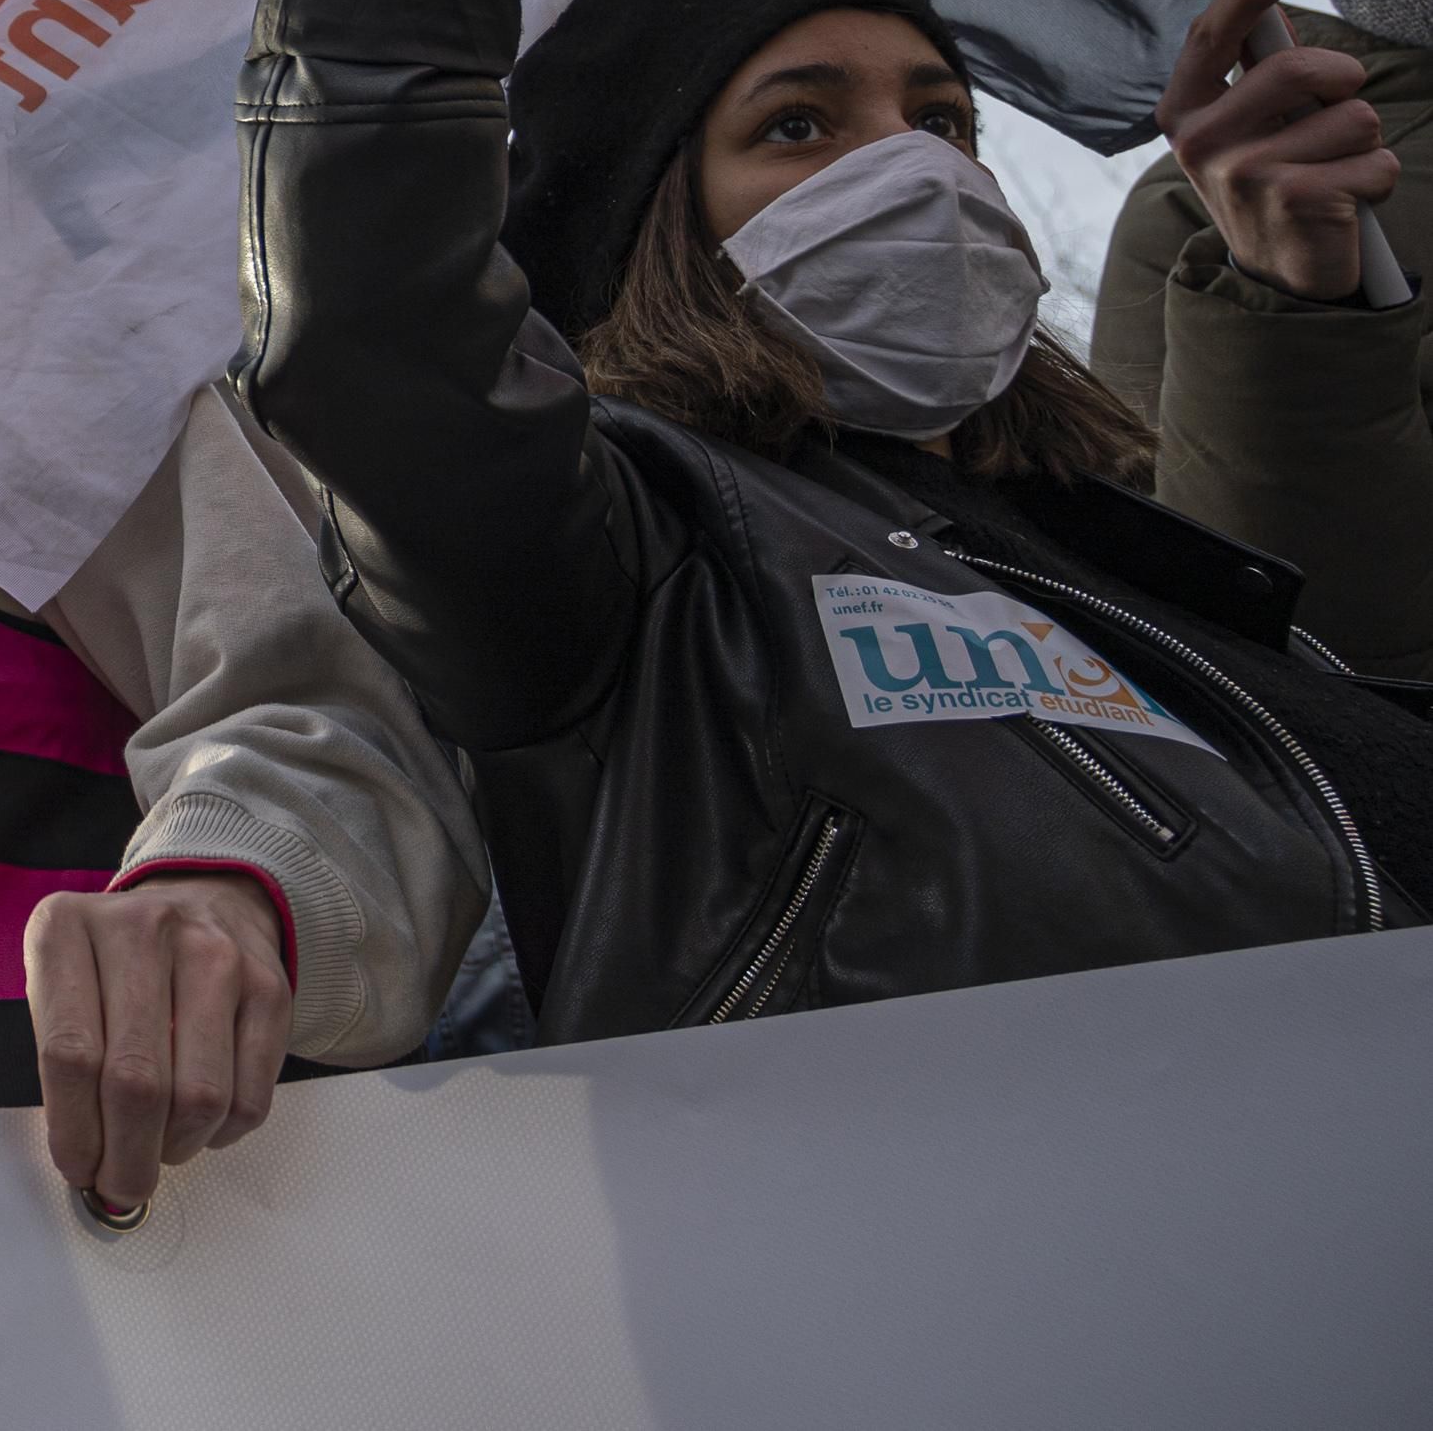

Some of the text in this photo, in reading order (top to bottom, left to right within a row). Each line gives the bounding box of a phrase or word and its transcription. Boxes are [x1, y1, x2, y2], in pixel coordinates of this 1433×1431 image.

[833, 600, 883, 616] unef.fr
[863, 683, 1154, 727] le syndicat étudiant
